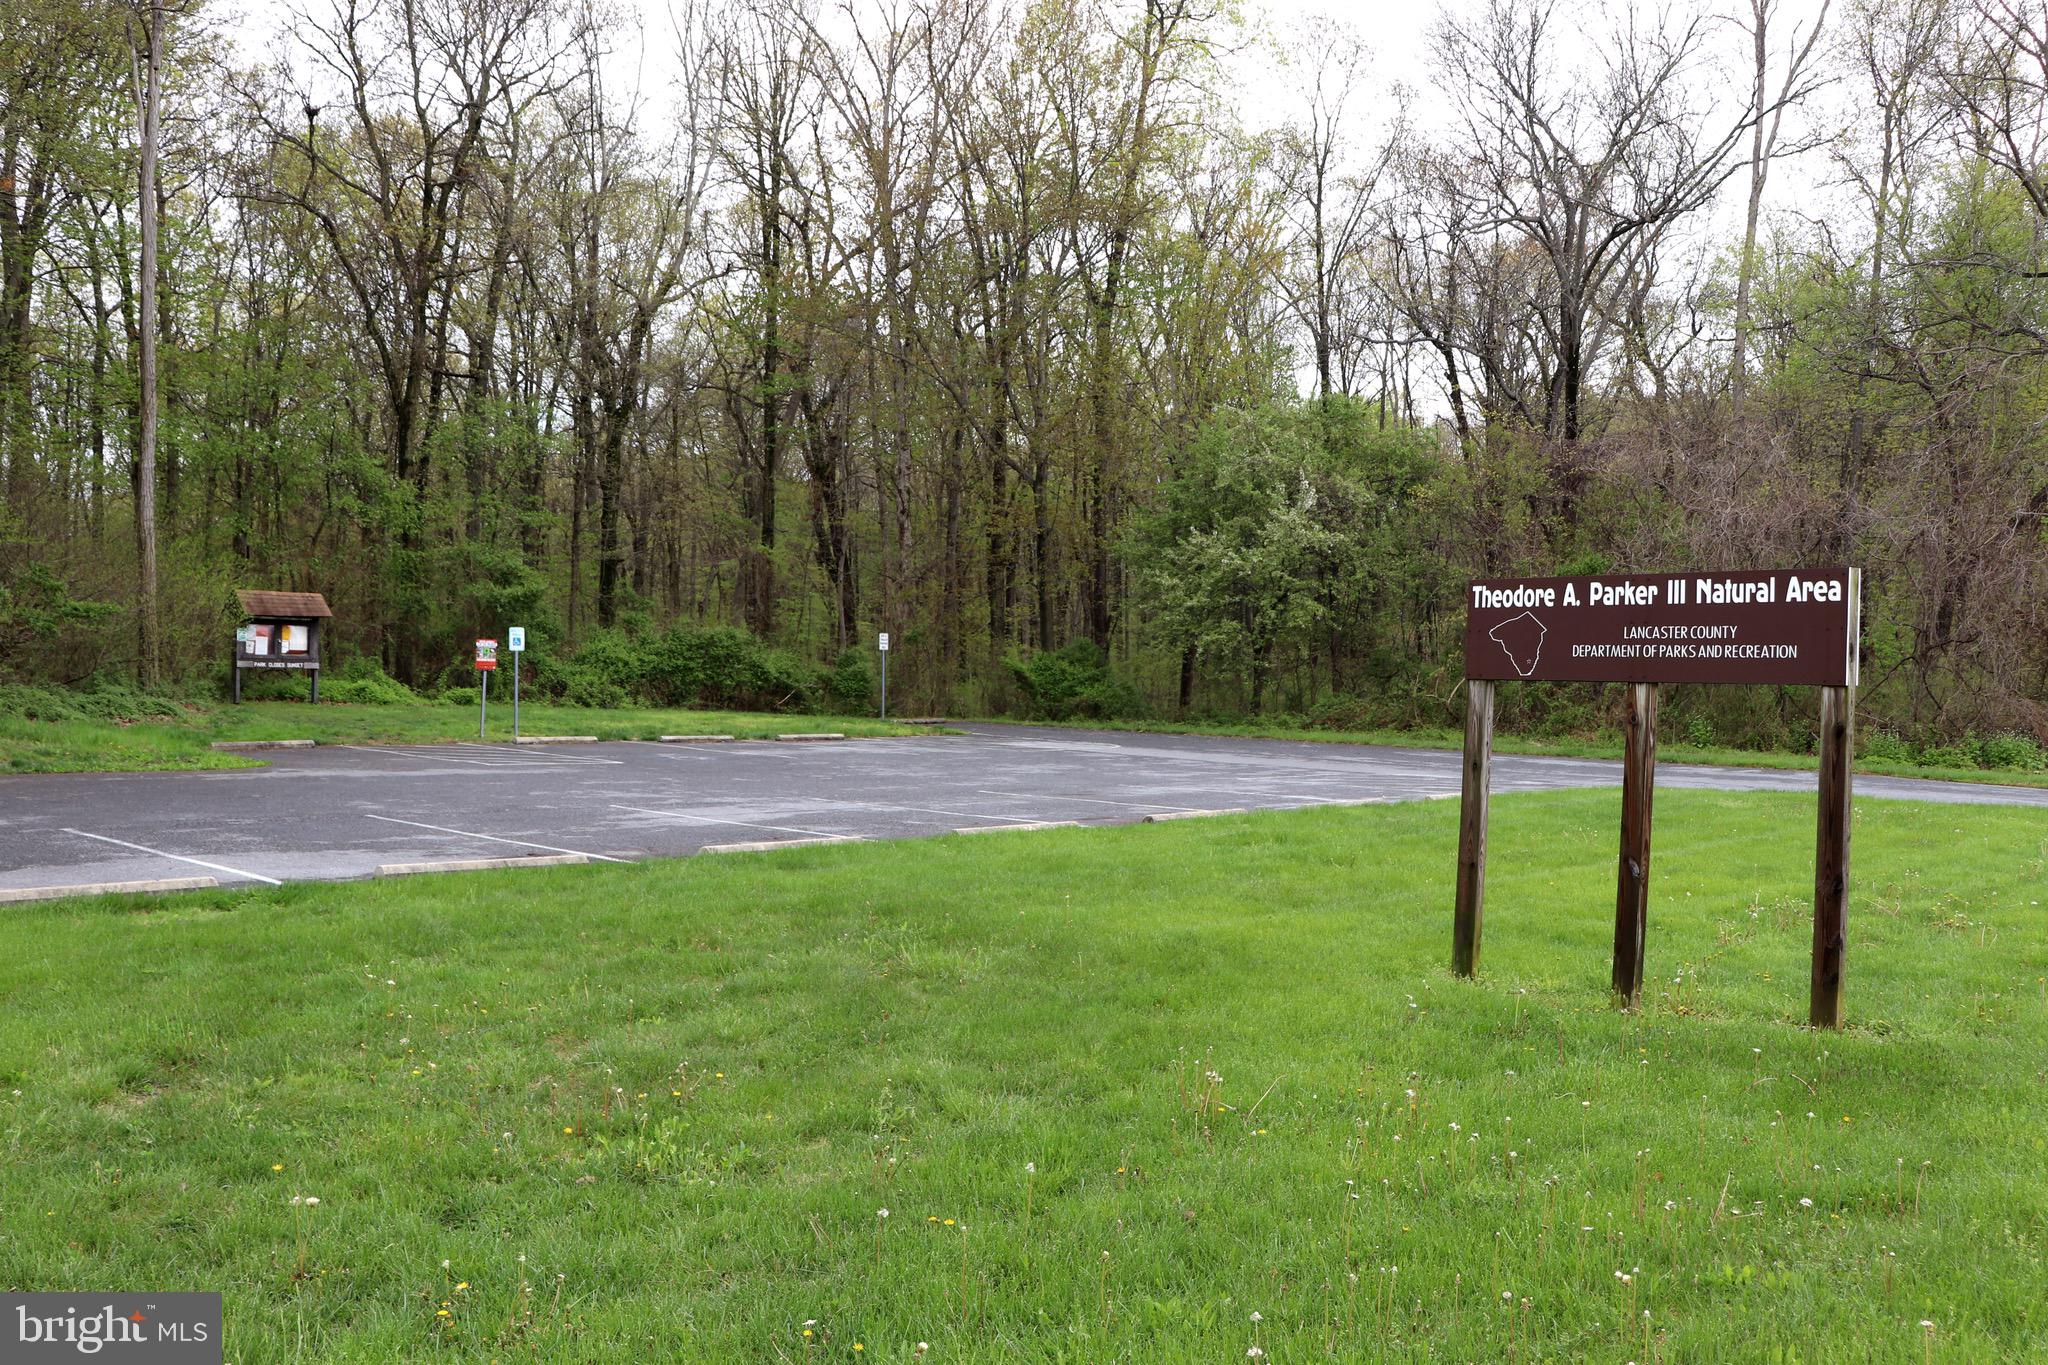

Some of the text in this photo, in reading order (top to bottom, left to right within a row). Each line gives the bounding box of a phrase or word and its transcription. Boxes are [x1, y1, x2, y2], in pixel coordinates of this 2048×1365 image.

[1472, 576, 1842, 609] Theodore A. Parker III Natural Area
[1623, 625, 1738, 640] LANCASTER COUNTY
[1572, 644, 1798, 659] DEPARTMENT OF PARKS AND RECREATION
